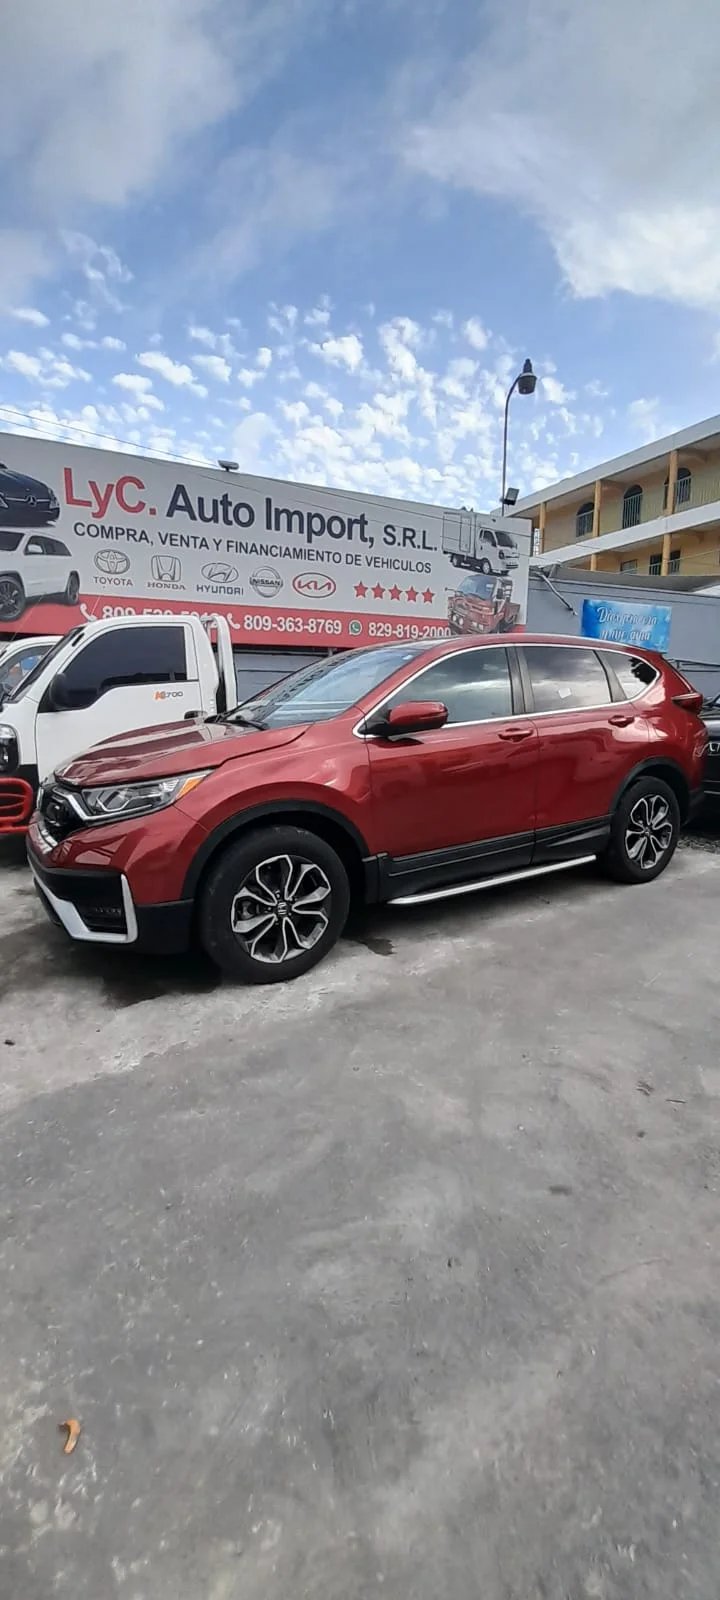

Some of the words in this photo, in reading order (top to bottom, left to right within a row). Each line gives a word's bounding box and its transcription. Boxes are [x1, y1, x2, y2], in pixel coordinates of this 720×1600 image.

[63, 467, 156, 519] LyC.
[166, 484, 255, 528] Auto
[265, 497, 374, 547] Import,
[382, 524, 438, 552] S.R.L.
[73, 522, 154, 546] COMPRA,
[158, 532, 210, 550] VENTA
[213, 538, 223, 551] Y
[226, 539, 342, 564] FINANCIAMIENTO
[345, 552, 362, 567] DE
[365, 555, 432, 574] VEHICULOS
[93, 576, 133, 587] TOYOTA
[147, 582, 186, 591] HONDA
[252, 578, 281, 586] NISSAN
[196, 584, 244, 596] HYUNDAI
[243, 615, 342, 634] 809-363-8769
[368, 622, 450, 639] 829-819-2000
